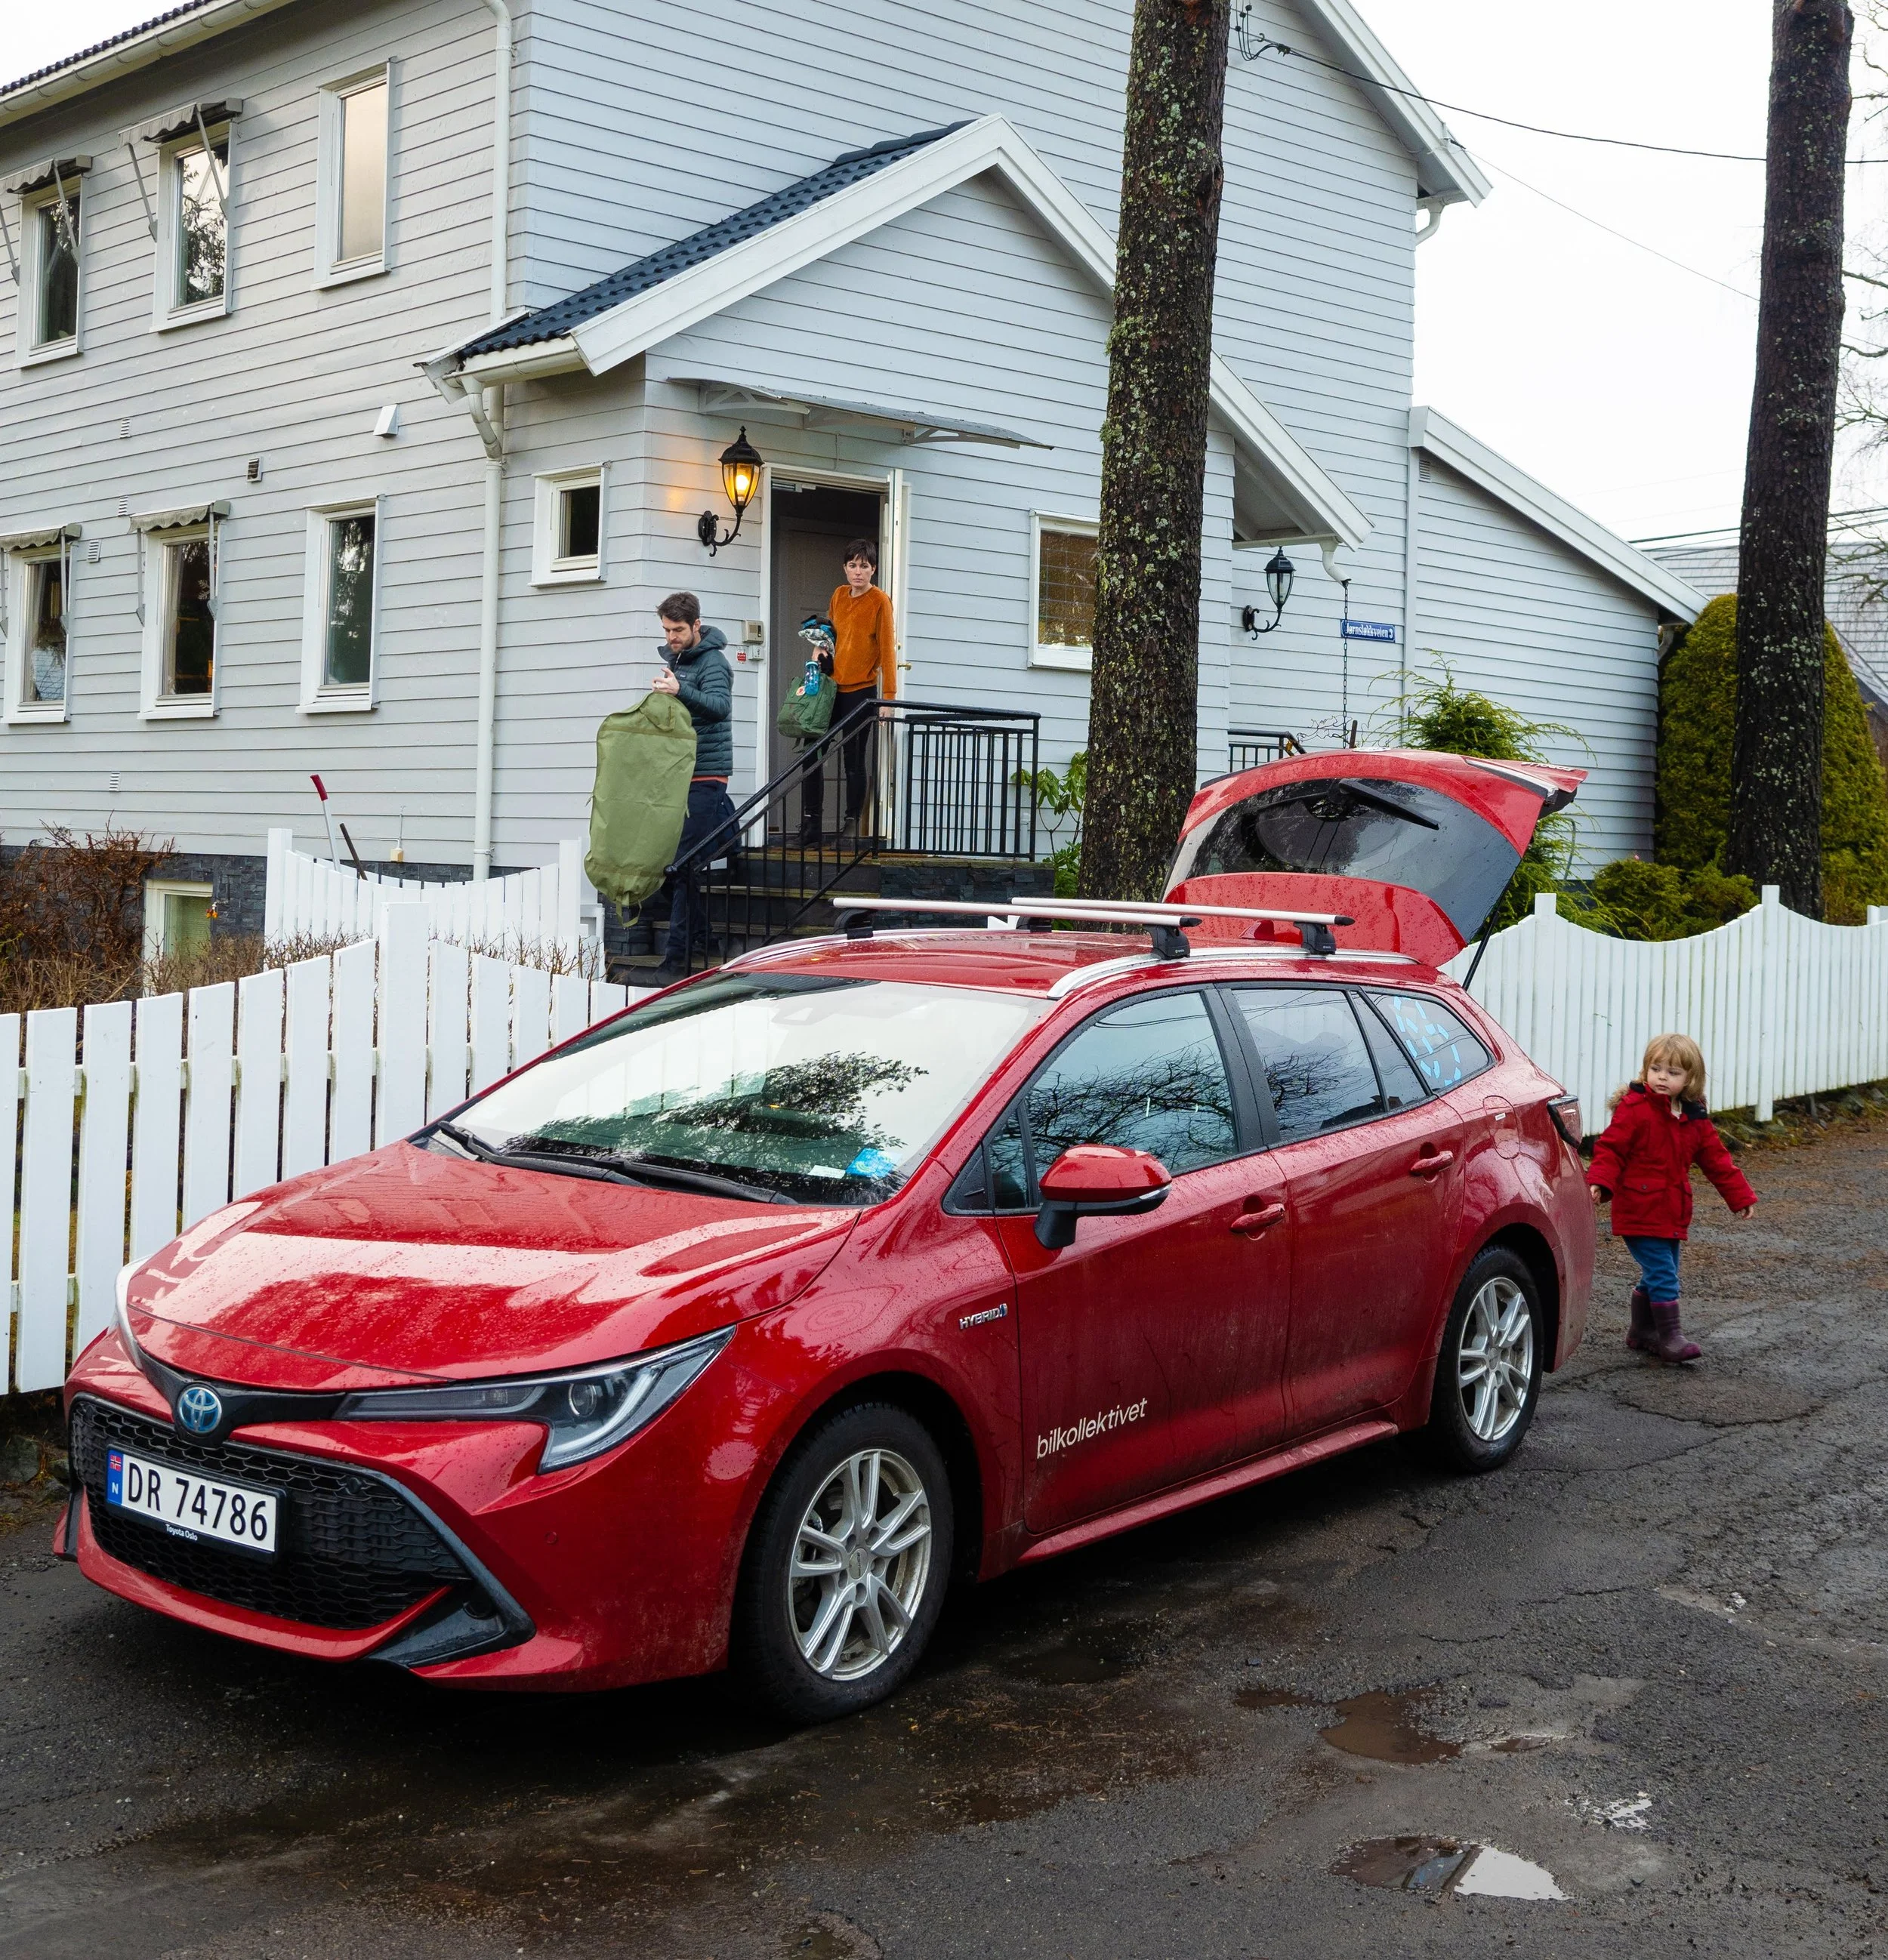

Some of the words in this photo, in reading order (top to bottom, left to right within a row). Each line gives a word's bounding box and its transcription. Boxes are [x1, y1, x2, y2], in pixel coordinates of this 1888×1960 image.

[1389, 628, 1393, 639] 3
[959, 1308, 1001, 1330] HYBRID
[1037, 1398, 1147, 1459] bilkollektivet
[112, 1482, 119, 1495] N
[128, 1462, 161, 1512] DR
[176, 1478, 267, 1541] 74786
[165, 1524, 184, 1536] Toyota
[185, 1530, 198, 1541] Oslo
